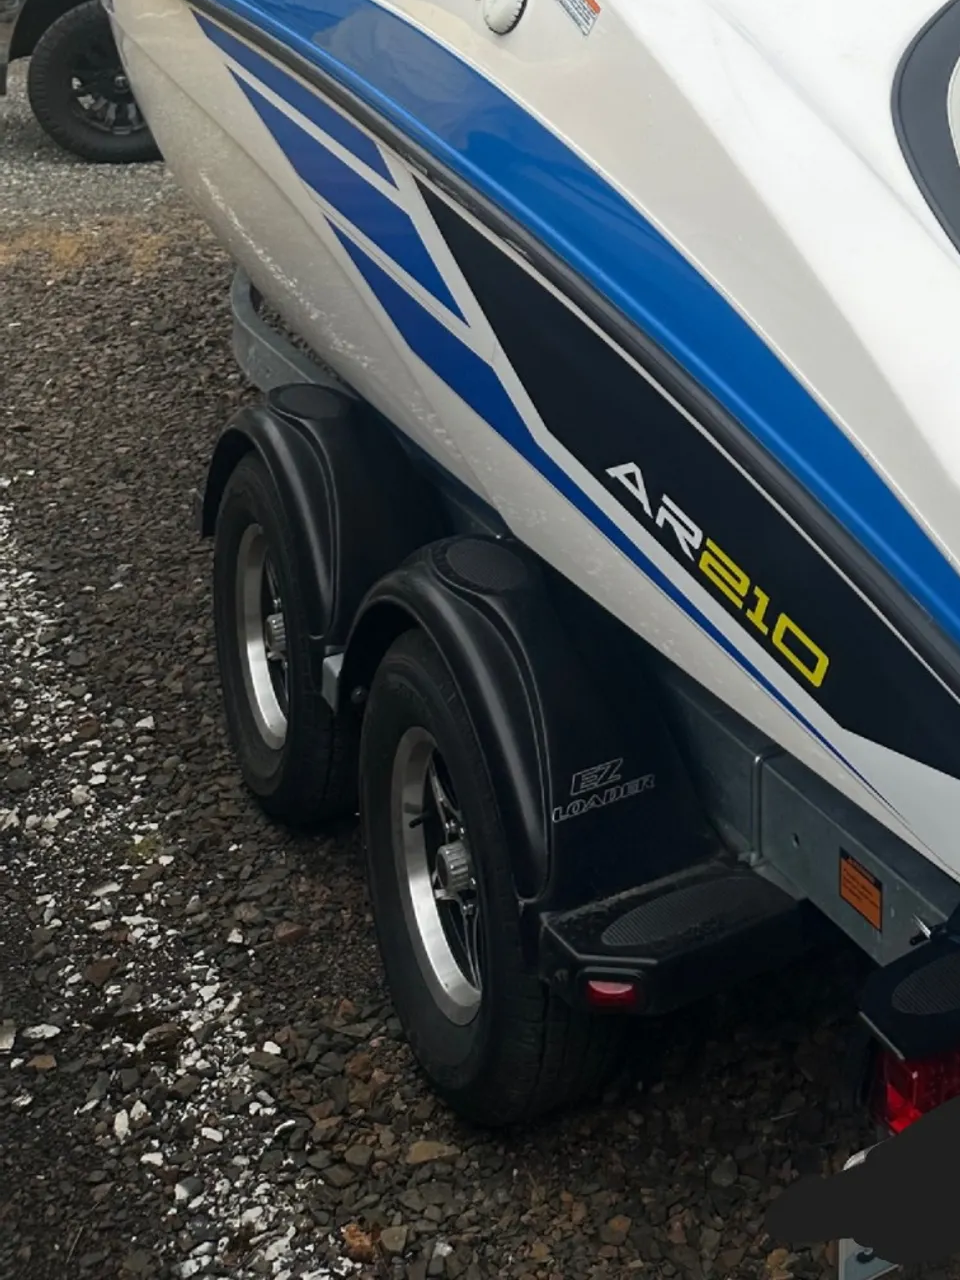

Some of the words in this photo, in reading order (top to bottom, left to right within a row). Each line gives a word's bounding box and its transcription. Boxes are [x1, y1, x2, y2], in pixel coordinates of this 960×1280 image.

[605, 461, 829, 687] AR210
[551, 773, 656, 823] LOADER
[570, 757, 624, 796] EZ
